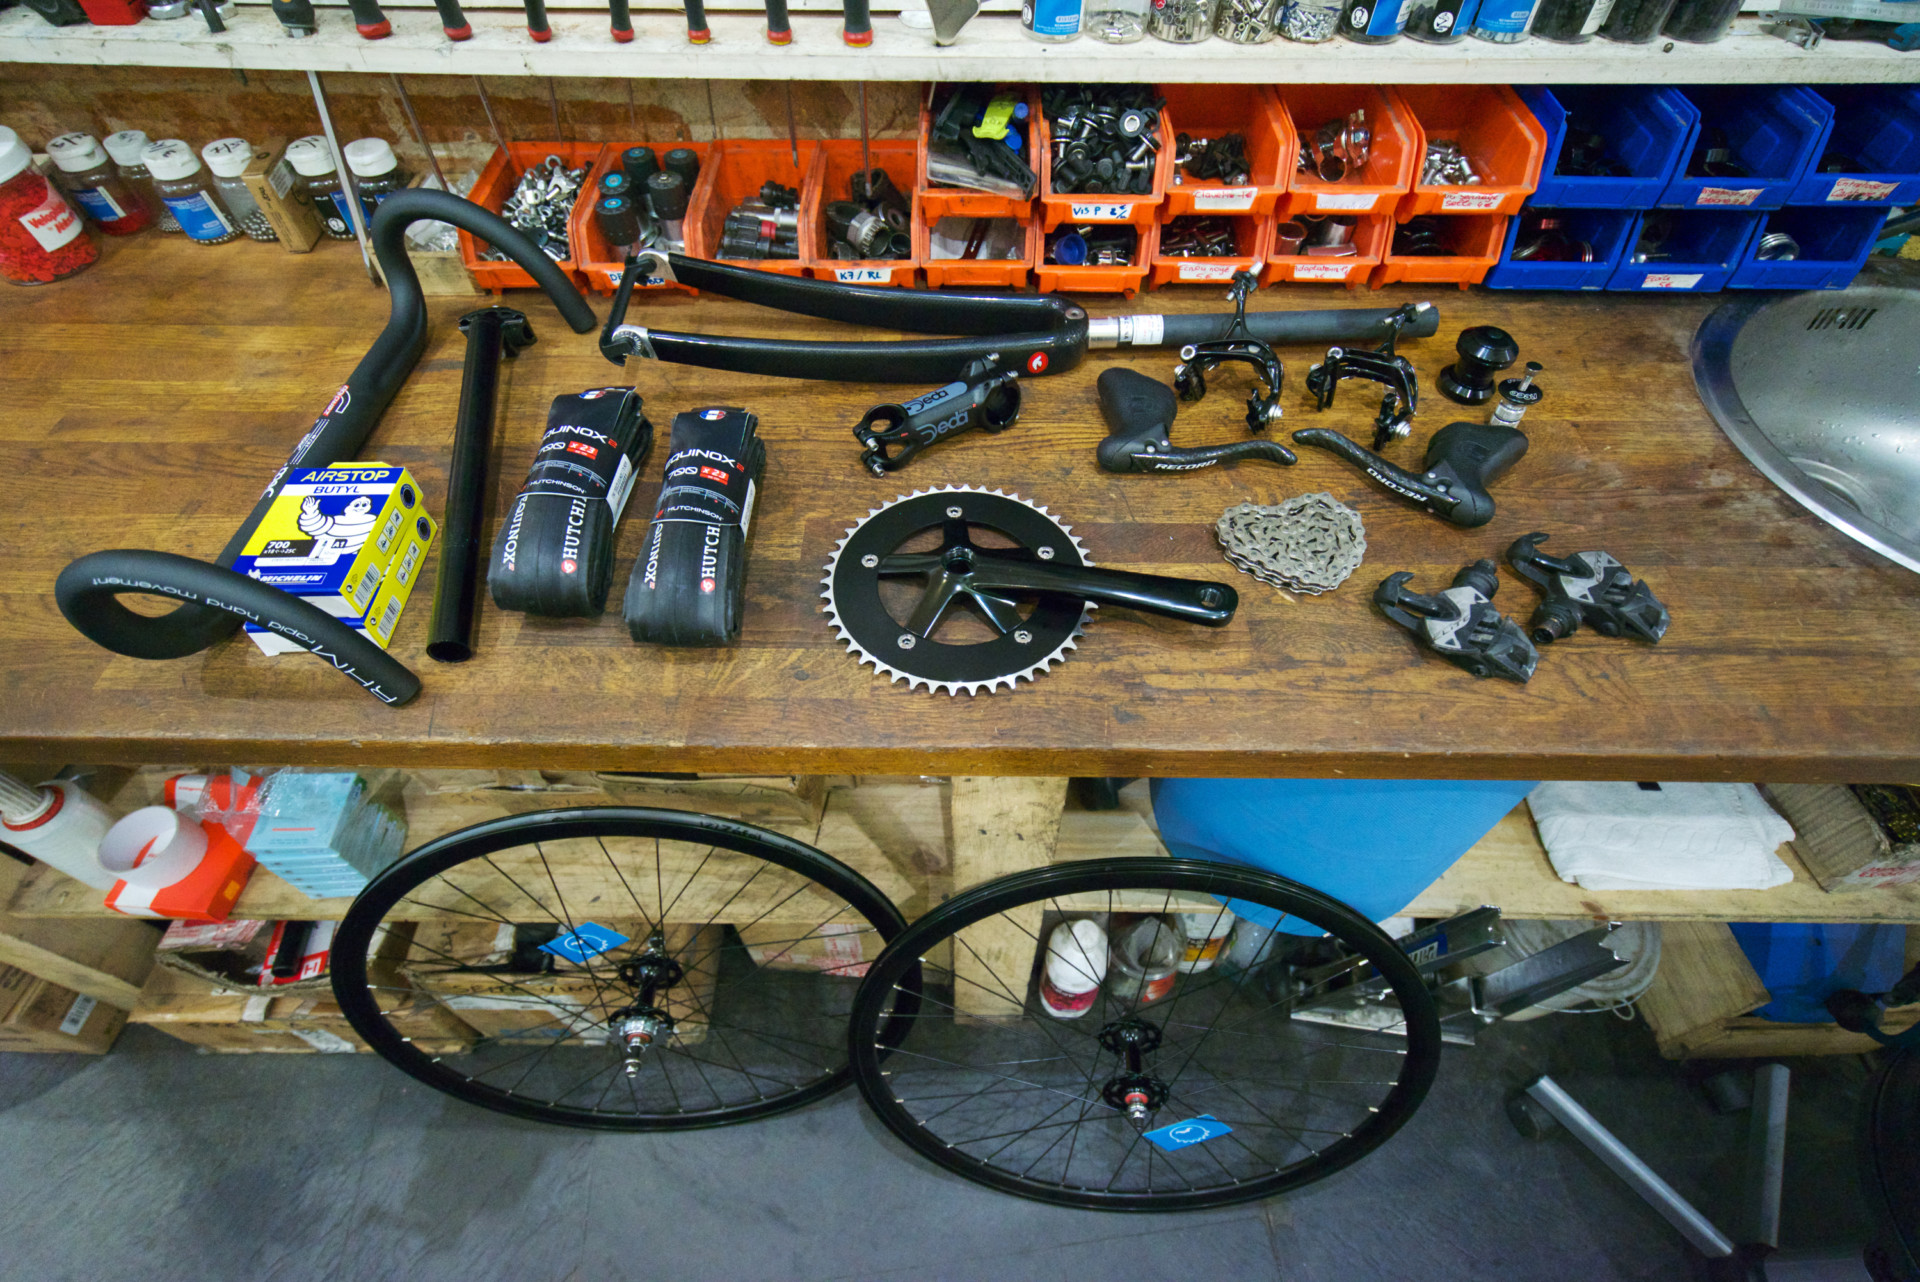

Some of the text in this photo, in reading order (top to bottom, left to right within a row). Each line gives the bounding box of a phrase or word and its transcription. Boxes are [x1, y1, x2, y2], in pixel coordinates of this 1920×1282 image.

[908, 389, 950, 412] Deda
[542, 424, 608, 444] QUINOX
[915, 410, 969, 446] Deda
[579, 443, 596, 455] 23
[1154, 459, 1218, 471] RECORD
[300, 470, 390, 482] AIRSTOP
[711, 468, 727, 479] 23
[313, 485, 361, 494] BUTYL
[530, 478, 585, 494] HUTCHINSON
[1365, 466, 1429, 502] RECORD
[666, 504, 723, 521] HUTCHINSON
[267, 541, 291, 549] 700
[259, 574, 323, 582] MICHELIN
[92, 576, 398, 704] RHM rapid hand movement
